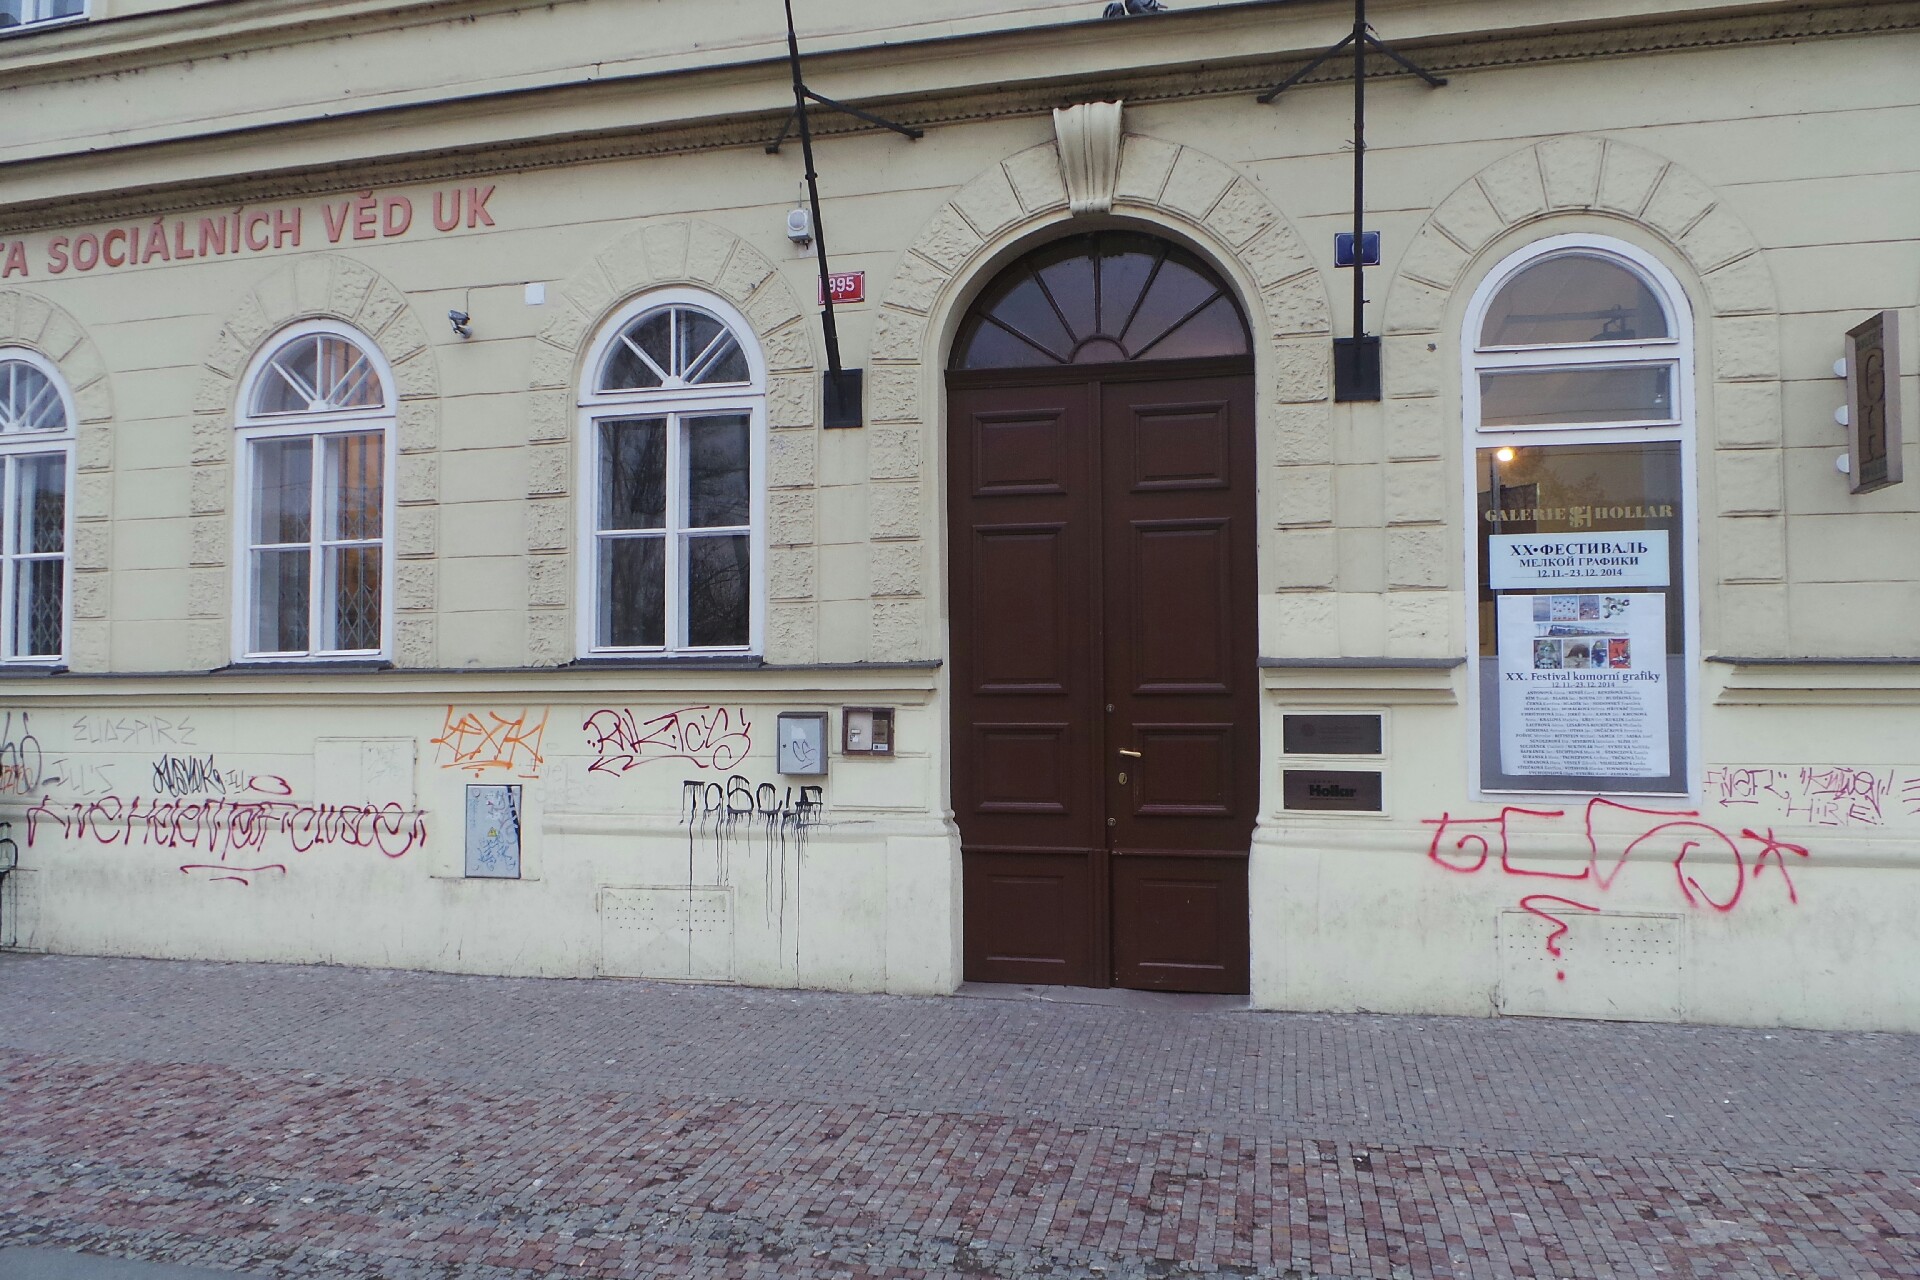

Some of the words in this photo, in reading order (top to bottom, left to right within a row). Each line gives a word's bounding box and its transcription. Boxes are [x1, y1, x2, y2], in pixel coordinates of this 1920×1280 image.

[47, 206, 301, 274] SOCIÁLNÍCH
[322, 190, 412, 243] VĚD
[432, 185, 496, 232] UK
[1485, 507, 1566, 522] GALERIE
[1595, 505, 1673, 519] HOLLAR
[1519, 556, 1575, 567] МЕЛКОЙ
[1578, 556, 1639, 567] ГРАФИКИ
[1600, 568, 1623, 577] 2014
[1506, 672, 1528, 681] XX.
[1531, 671, 1571, 681] Festival
[1573, 670, 1620, 681] komorní
[1622, 670, 1660, 683] grafiky
[1309, 784, 1357, 797] Hollar
